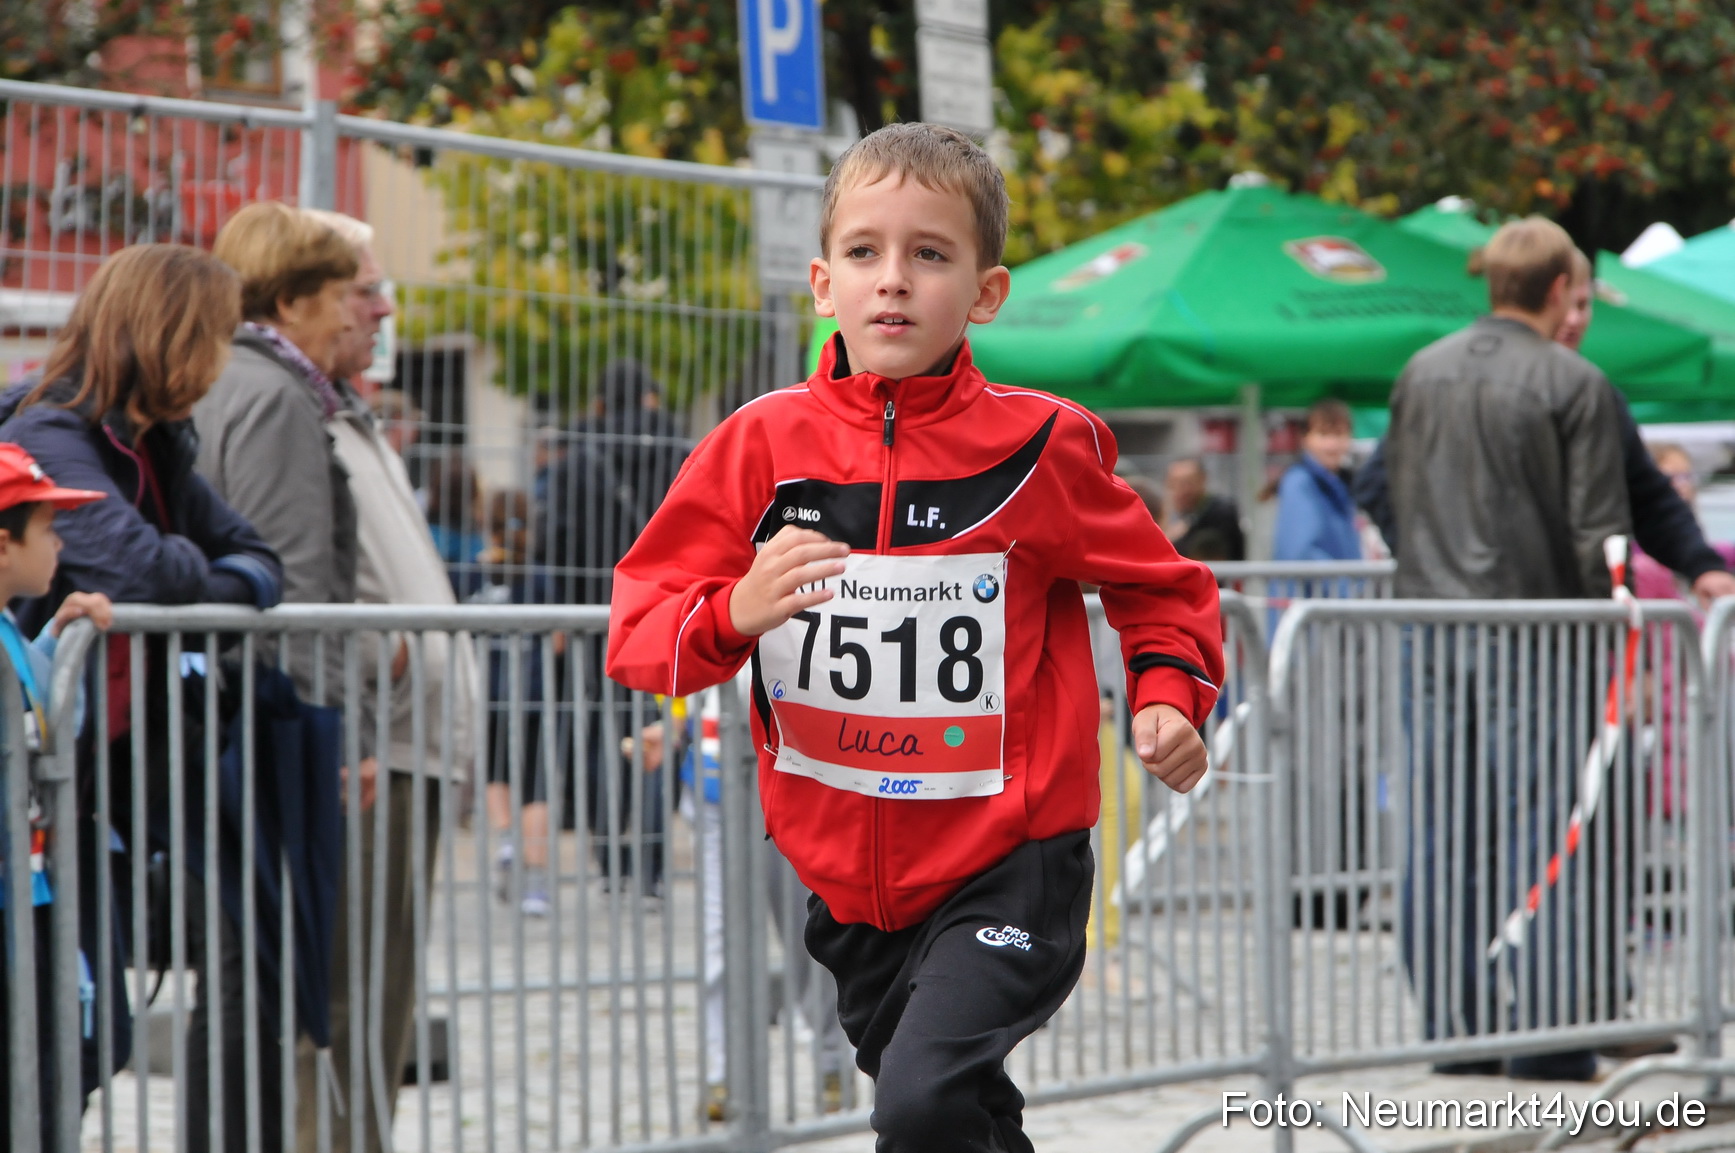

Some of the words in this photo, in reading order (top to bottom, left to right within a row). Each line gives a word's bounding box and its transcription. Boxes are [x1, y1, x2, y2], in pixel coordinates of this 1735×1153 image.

[758, 0, 803, 103] P
[907, 504, 945, 529] L.F.
[840, 579, 963, 602] Neumarkt
[791, 610, 984, 703] 7518
[772, 680, 784, 700] 6
[985, 695, 995, 710] K
[838, 716, 924, 756] Luca
[878, 777, 923, 795] 2005
[987, 930, 1032, 951] TOUCH
[1002, 925, 1030, 941] PRO
